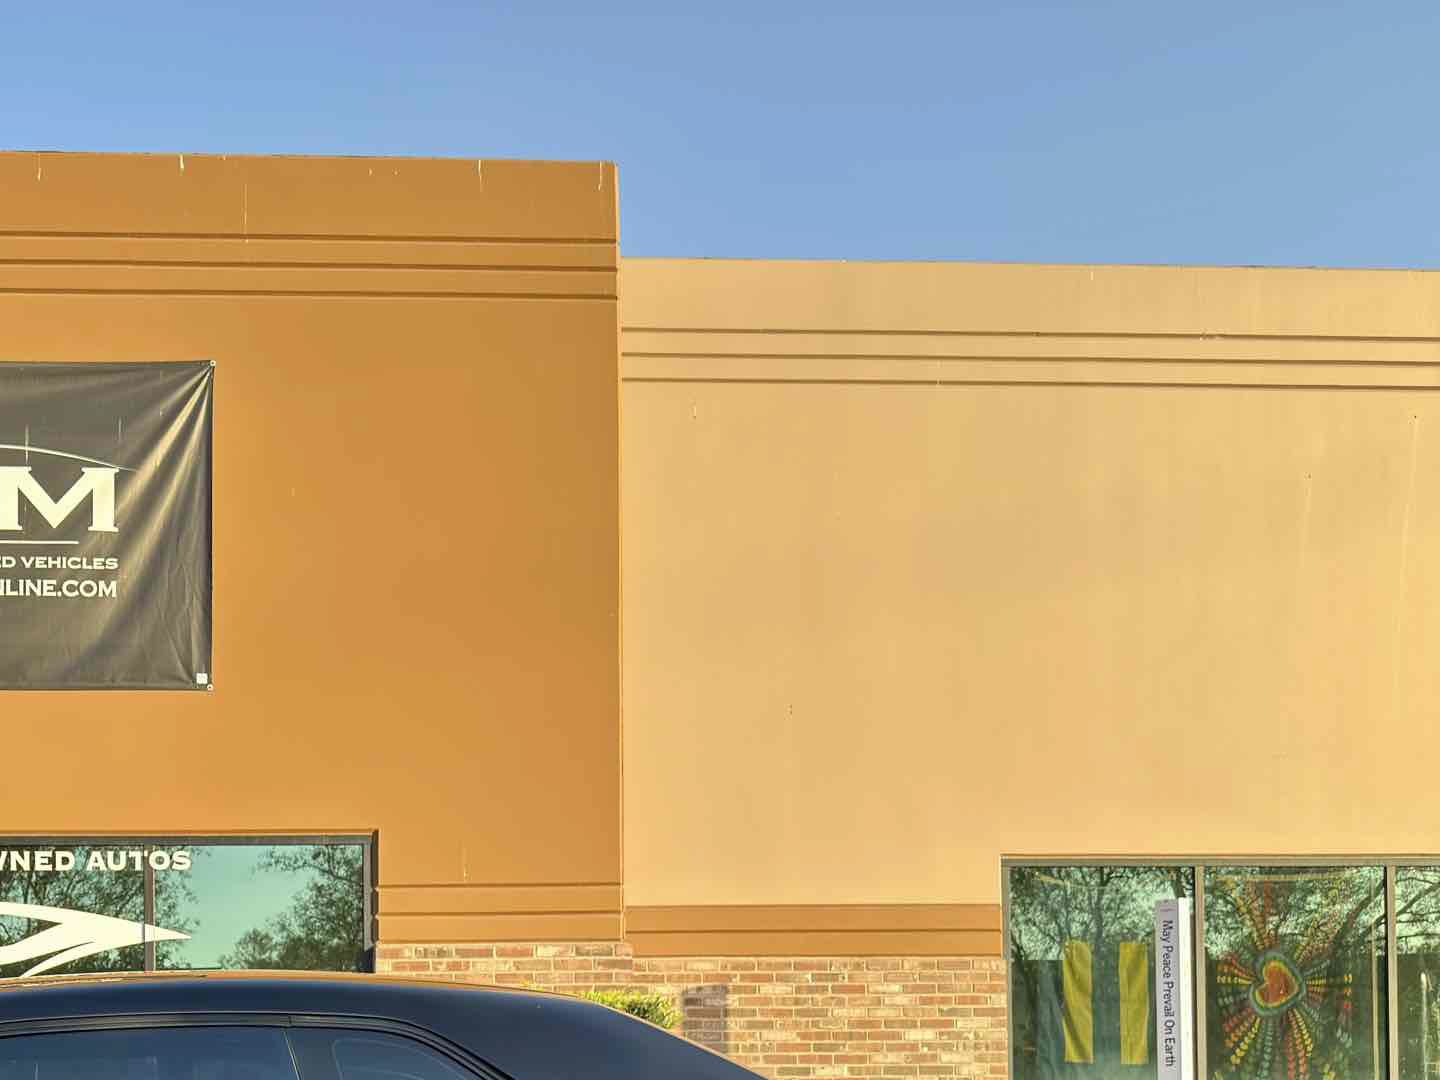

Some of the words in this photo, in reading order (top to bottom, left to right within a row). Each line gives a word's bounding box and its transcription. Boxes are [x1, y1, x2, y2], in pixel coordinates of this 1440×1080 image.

[20, 556, 119, 570] VEHICLES
[85, 850, 193, 871] AUTOS
[1159, 919, 1174, 943] May
[1162, 945, 1174, 978] Peace
[1163, 980, 1175, 1017] Prevail
[1164, 1020, 1176, 1036] On
[1165, 1036, 1177, 1067] Earth
